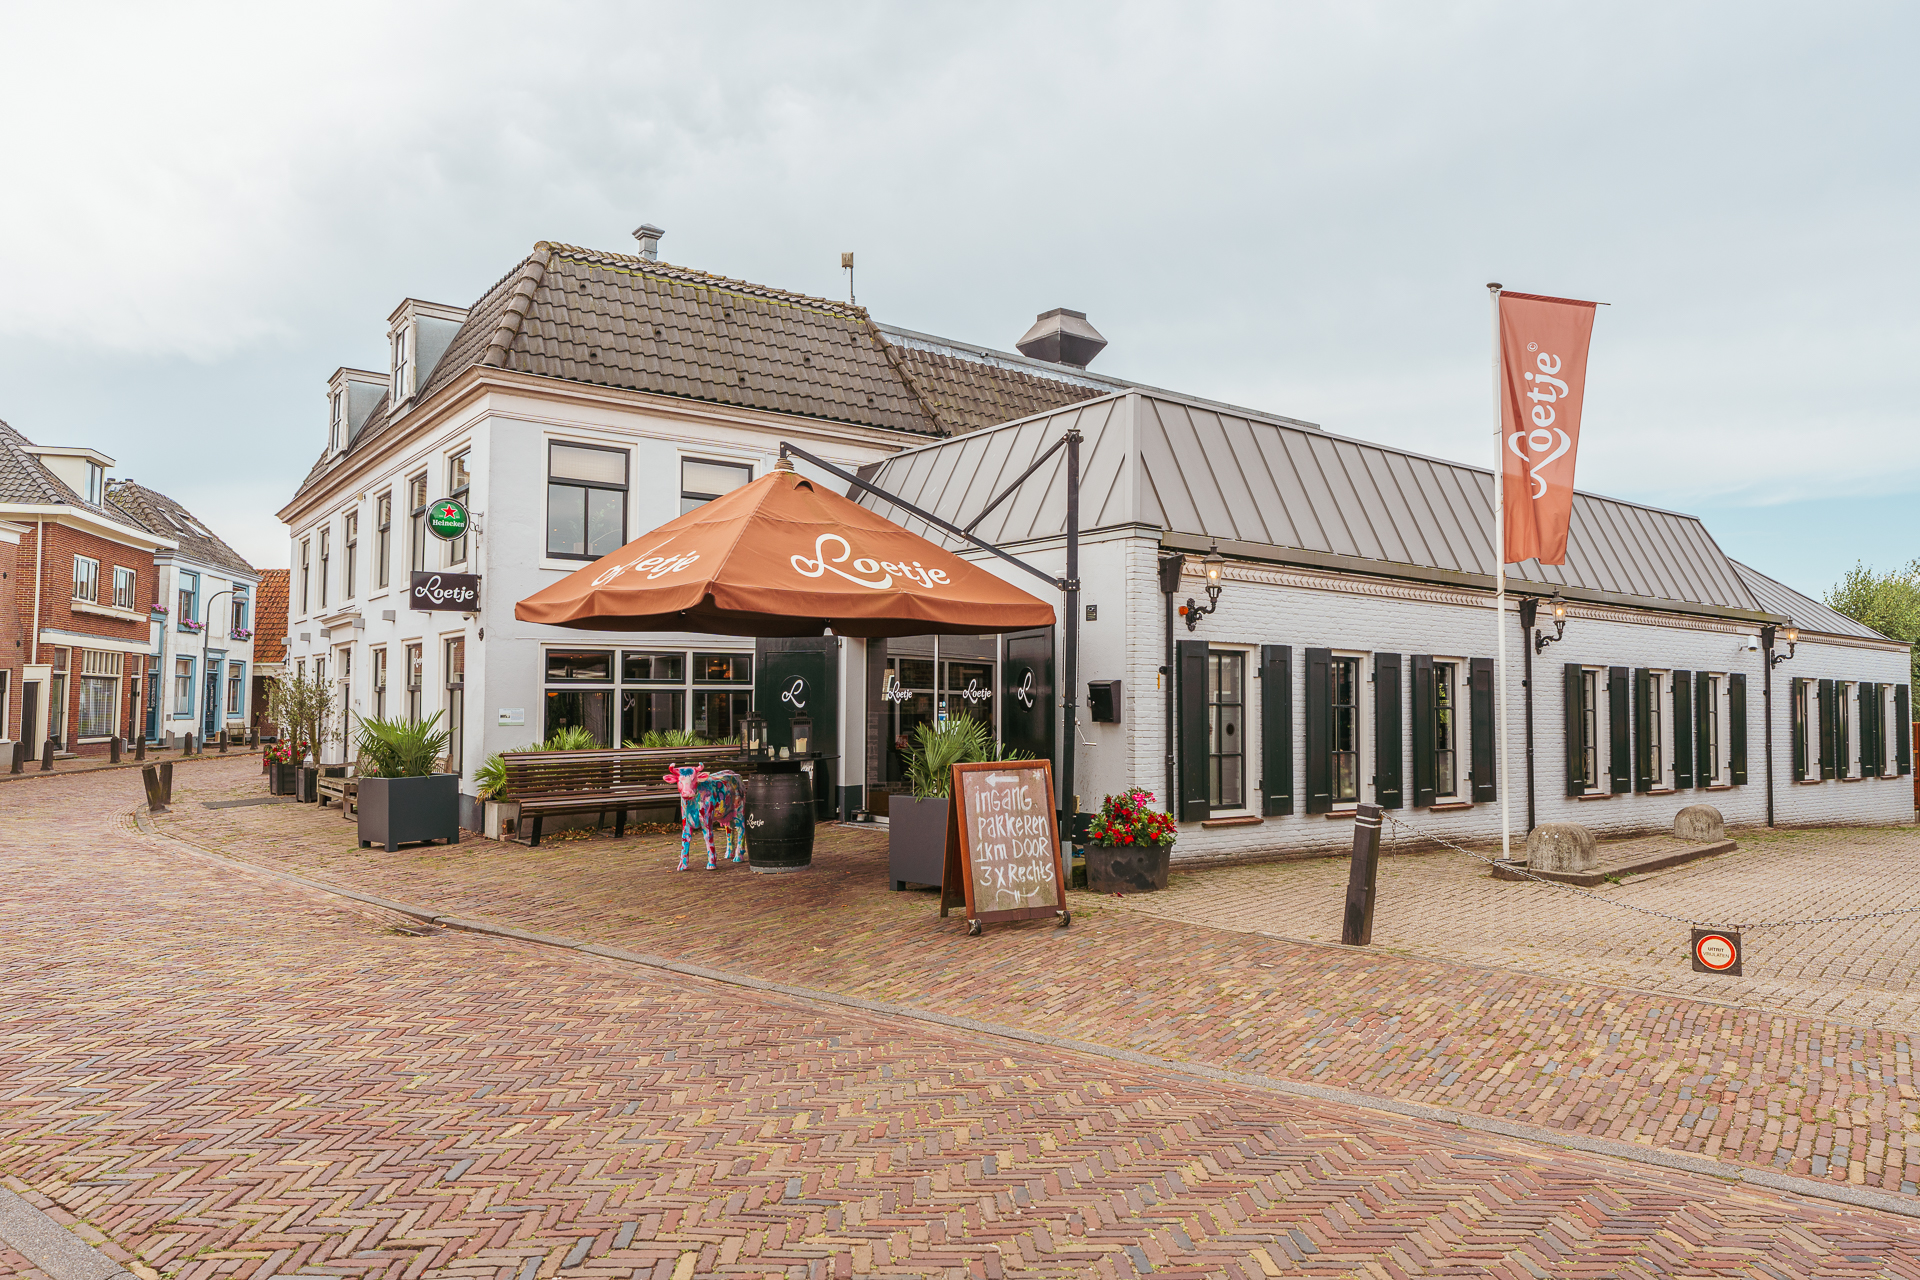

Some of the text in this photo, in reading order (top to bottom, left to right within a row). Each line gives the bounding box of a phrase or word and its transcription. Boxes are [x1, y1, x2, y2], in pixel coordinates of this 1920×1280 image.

[432, 519, 465, 528] Heineken
[790, 533, 950, 589] Loetje
[414, 575, 474, 604] Loetje
[888, 680, 913, 704] Loetje
[962, 678, 992, 704] Loetje
[746, 813, 765, 829] Loetje
[1012, 837, 1050, 859] DOOR
